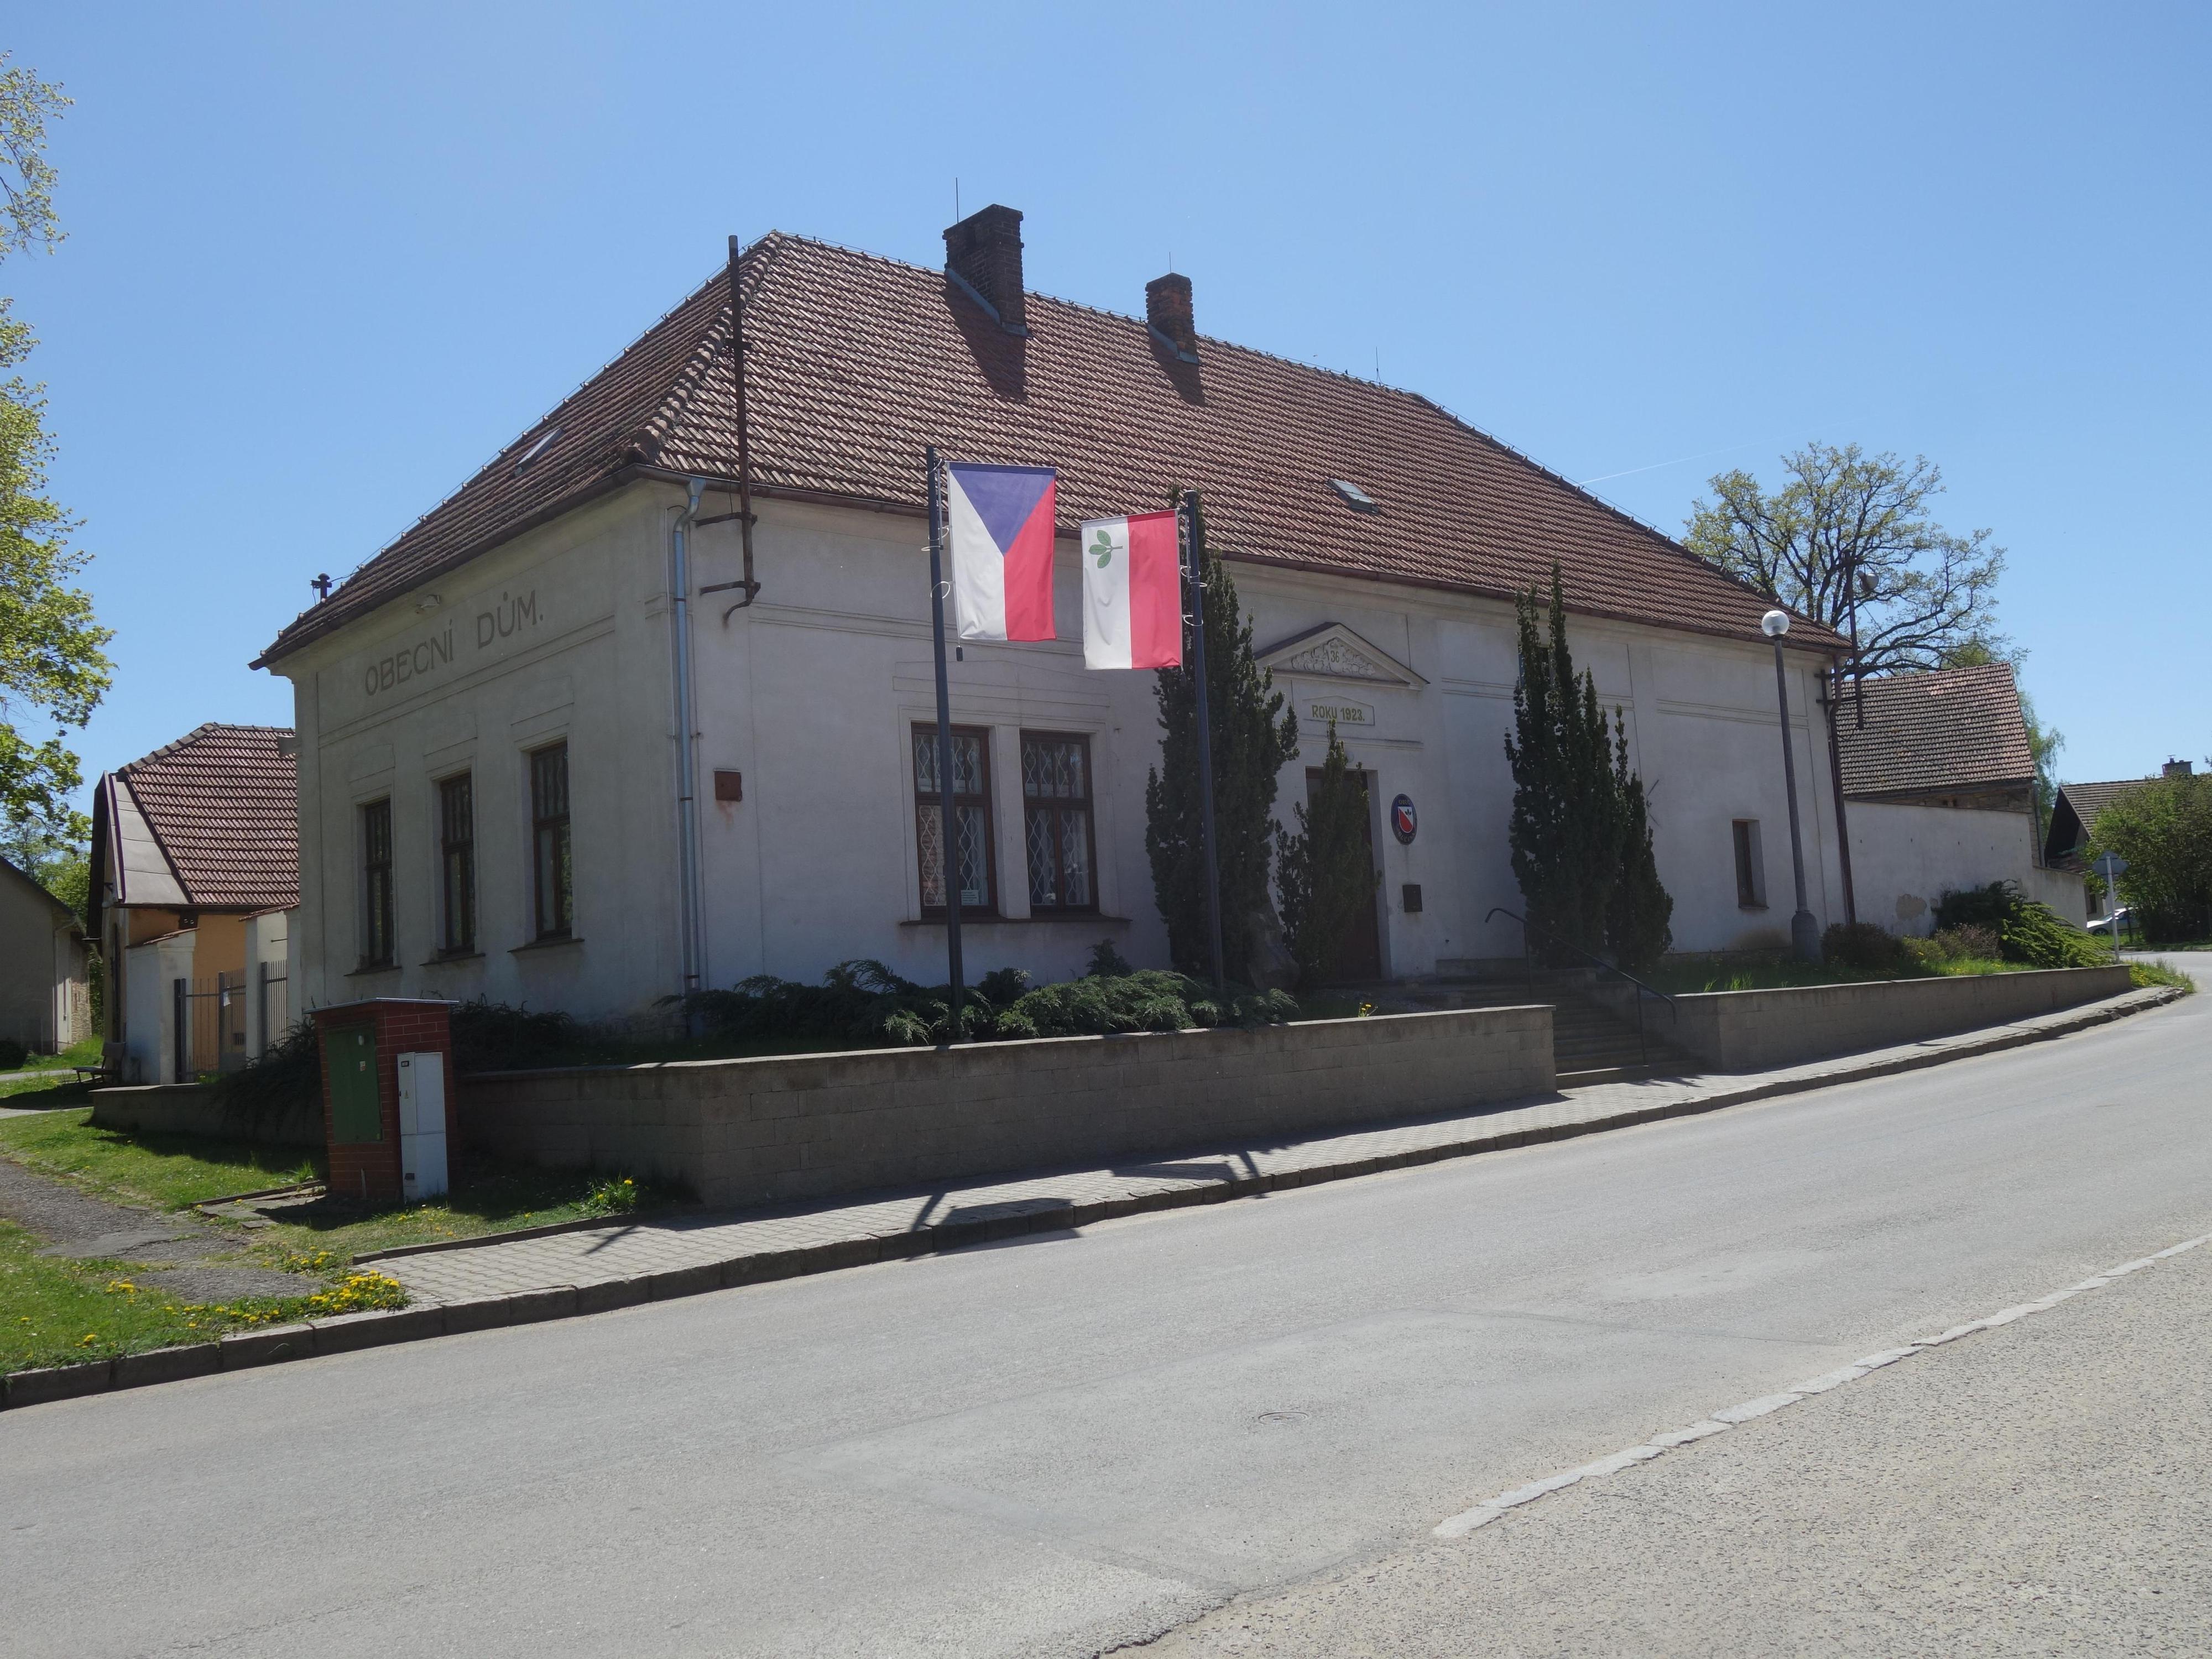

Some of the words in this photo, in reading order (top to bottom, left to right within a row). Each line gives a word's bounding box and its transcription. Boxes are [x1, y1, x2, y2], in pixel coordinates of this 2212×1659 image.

[365, 619, 453, 696] OBECNÍ
[477, 589, 544, 650] DŮM.
[1331, 650, 1340, 663] 36
[1312, 705, 1337, 719] ROKU
